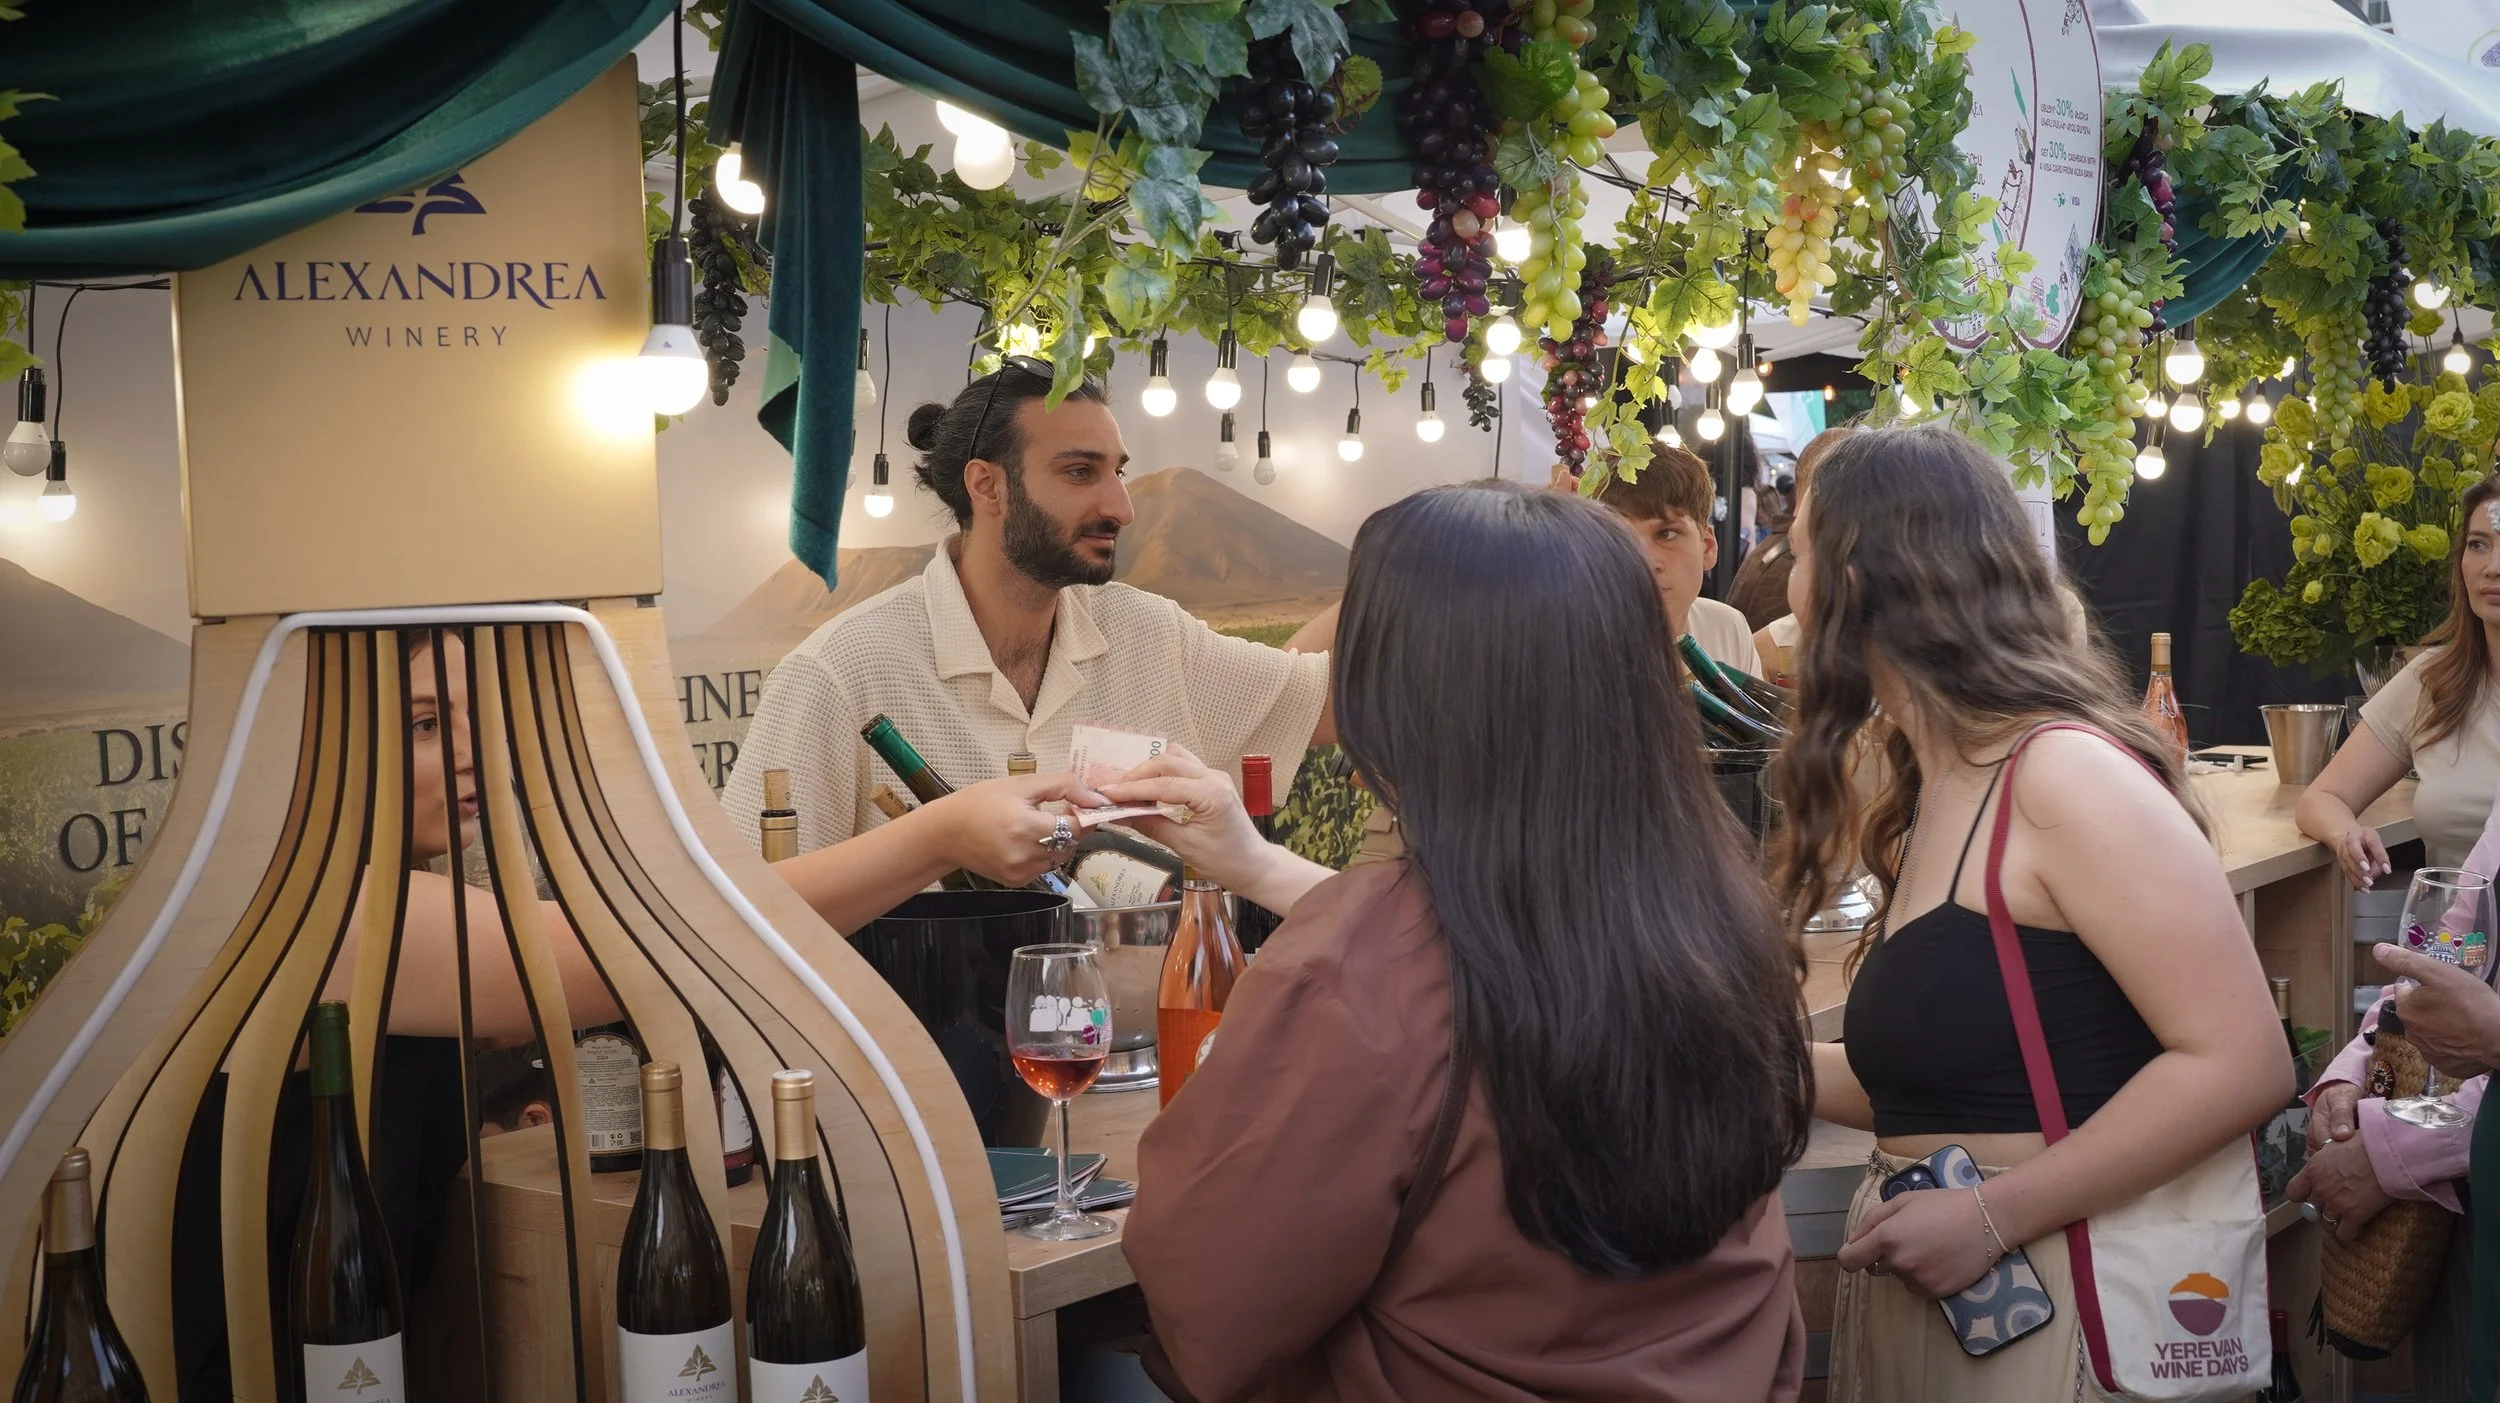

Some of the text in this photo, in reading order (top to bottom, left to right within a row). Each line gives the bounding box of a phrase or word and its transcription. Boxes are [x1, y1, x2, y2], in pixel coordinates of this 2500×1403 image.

[2056, 99, 2074, 119] 30%
[2048, 141, 2067, 160] 30%
[233, 261, 608, 310] ALEXANDREA
[345, 326, 508, 348] WINERY
[1149, 741, 1161, 760] 00
[59, 808, 147, 873] OF
[2154, 1337, 2244, 1360] YEREVAN
[2150, 1355, 2249, 1379] WINE DAYS
[668, 1380, 726, 1397] ALEXANDREA
